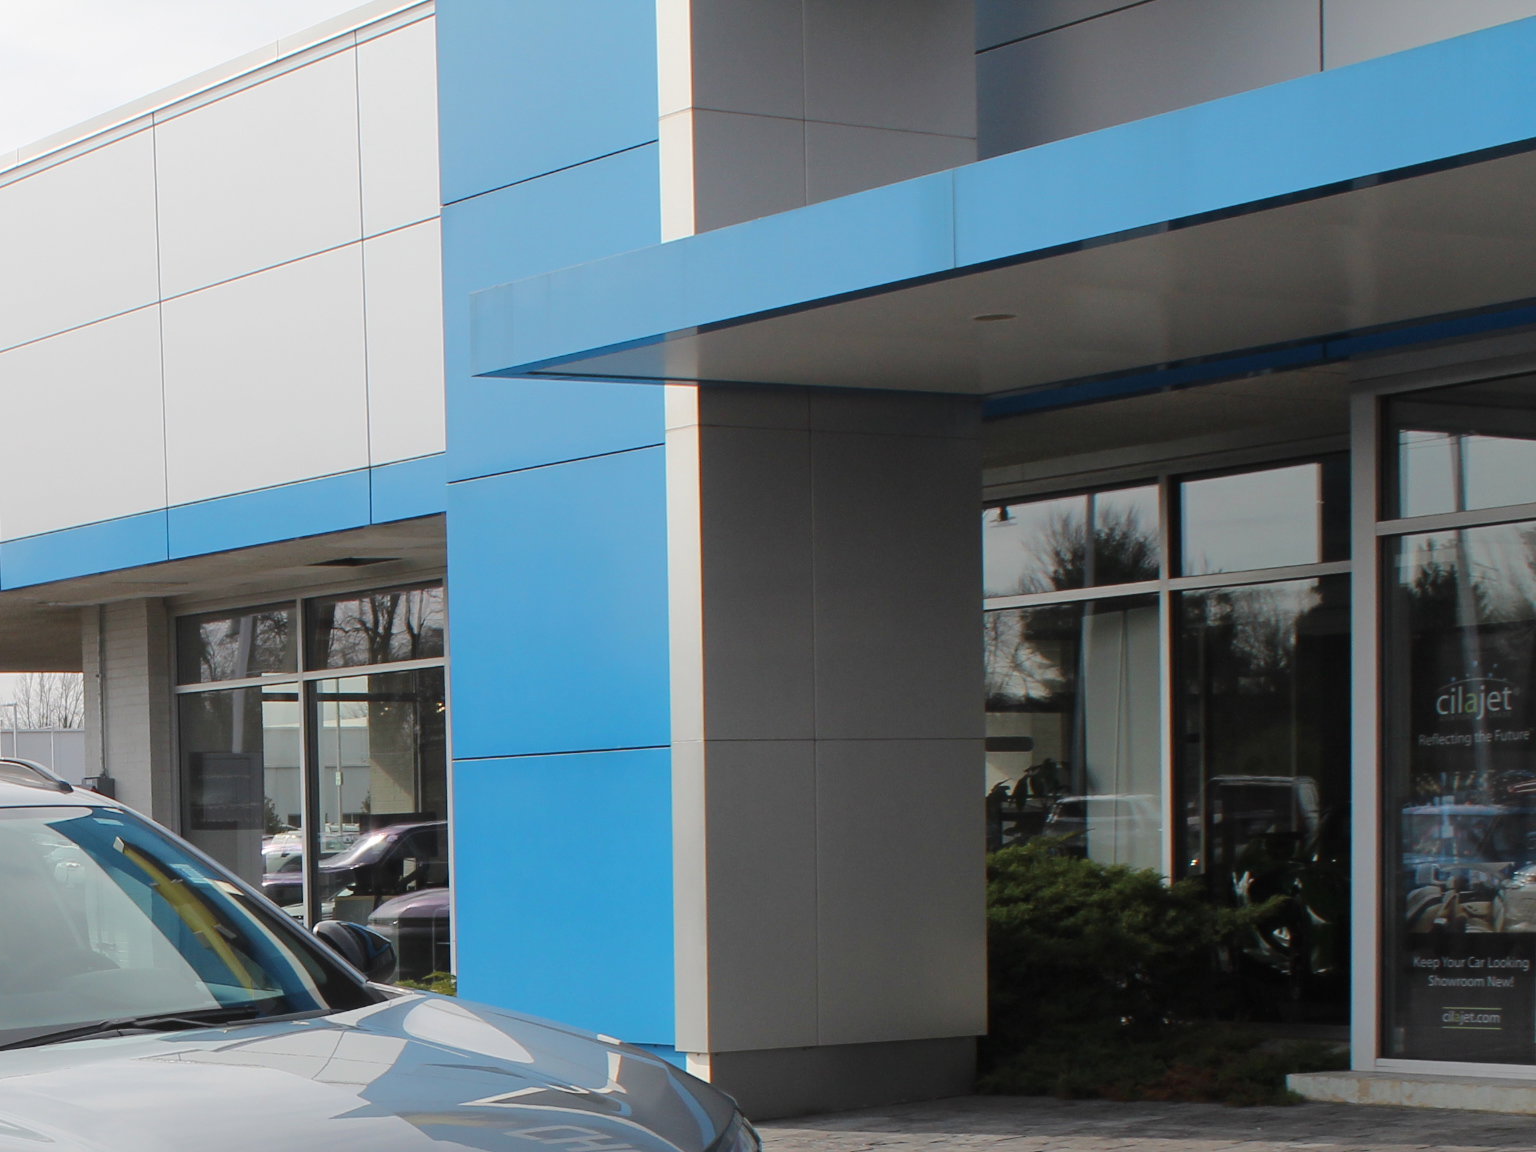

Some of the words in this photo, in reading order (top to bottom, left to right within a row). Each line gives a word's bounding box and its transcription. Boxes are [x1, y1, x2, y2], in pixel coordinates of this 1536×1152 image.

[1436, 685, 1512, 720] cilajet
[1418, 732, 1472, 746] Reflecting
[1474, 730, 1492, 742] the
[1494, 729, 1531, 741] Future
[1412, 957, 1440, 970] Keep
[1441, 957, 1465, 968] Your
[1467, 956, 1485, 968] Car
[1487, 957, 1530, 972] Looking
[1427, 975, 1485, 987] Showroom
[1487, 976, 1514, 987] New!
[1442, 1010, 1501, 1025] cilajet.com
